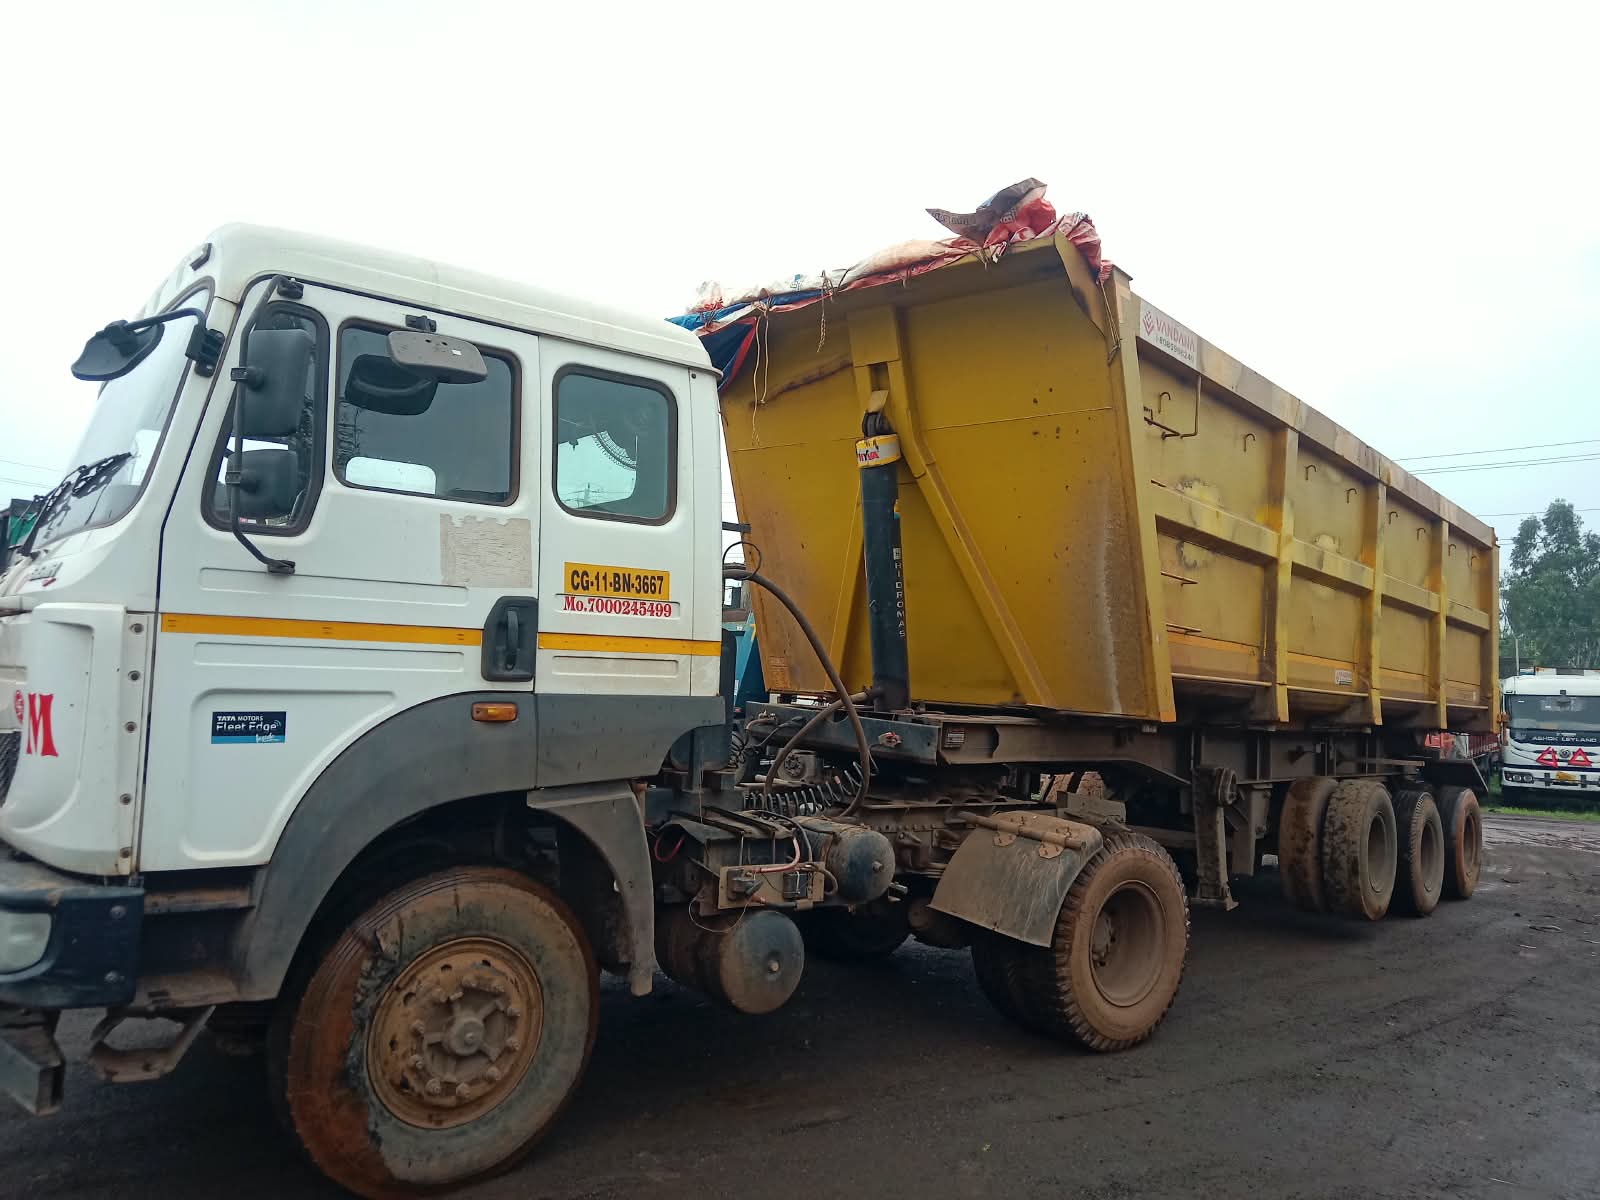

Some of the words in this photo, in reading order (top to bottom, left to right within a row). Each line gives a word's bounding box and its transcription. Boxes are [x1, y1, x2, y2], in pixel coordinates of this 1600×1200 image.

[563, 595, 672, 617] Mo.7000245499
[216, 721, 246, 732] Fleet
[248, 721, 277, 732] Edge
